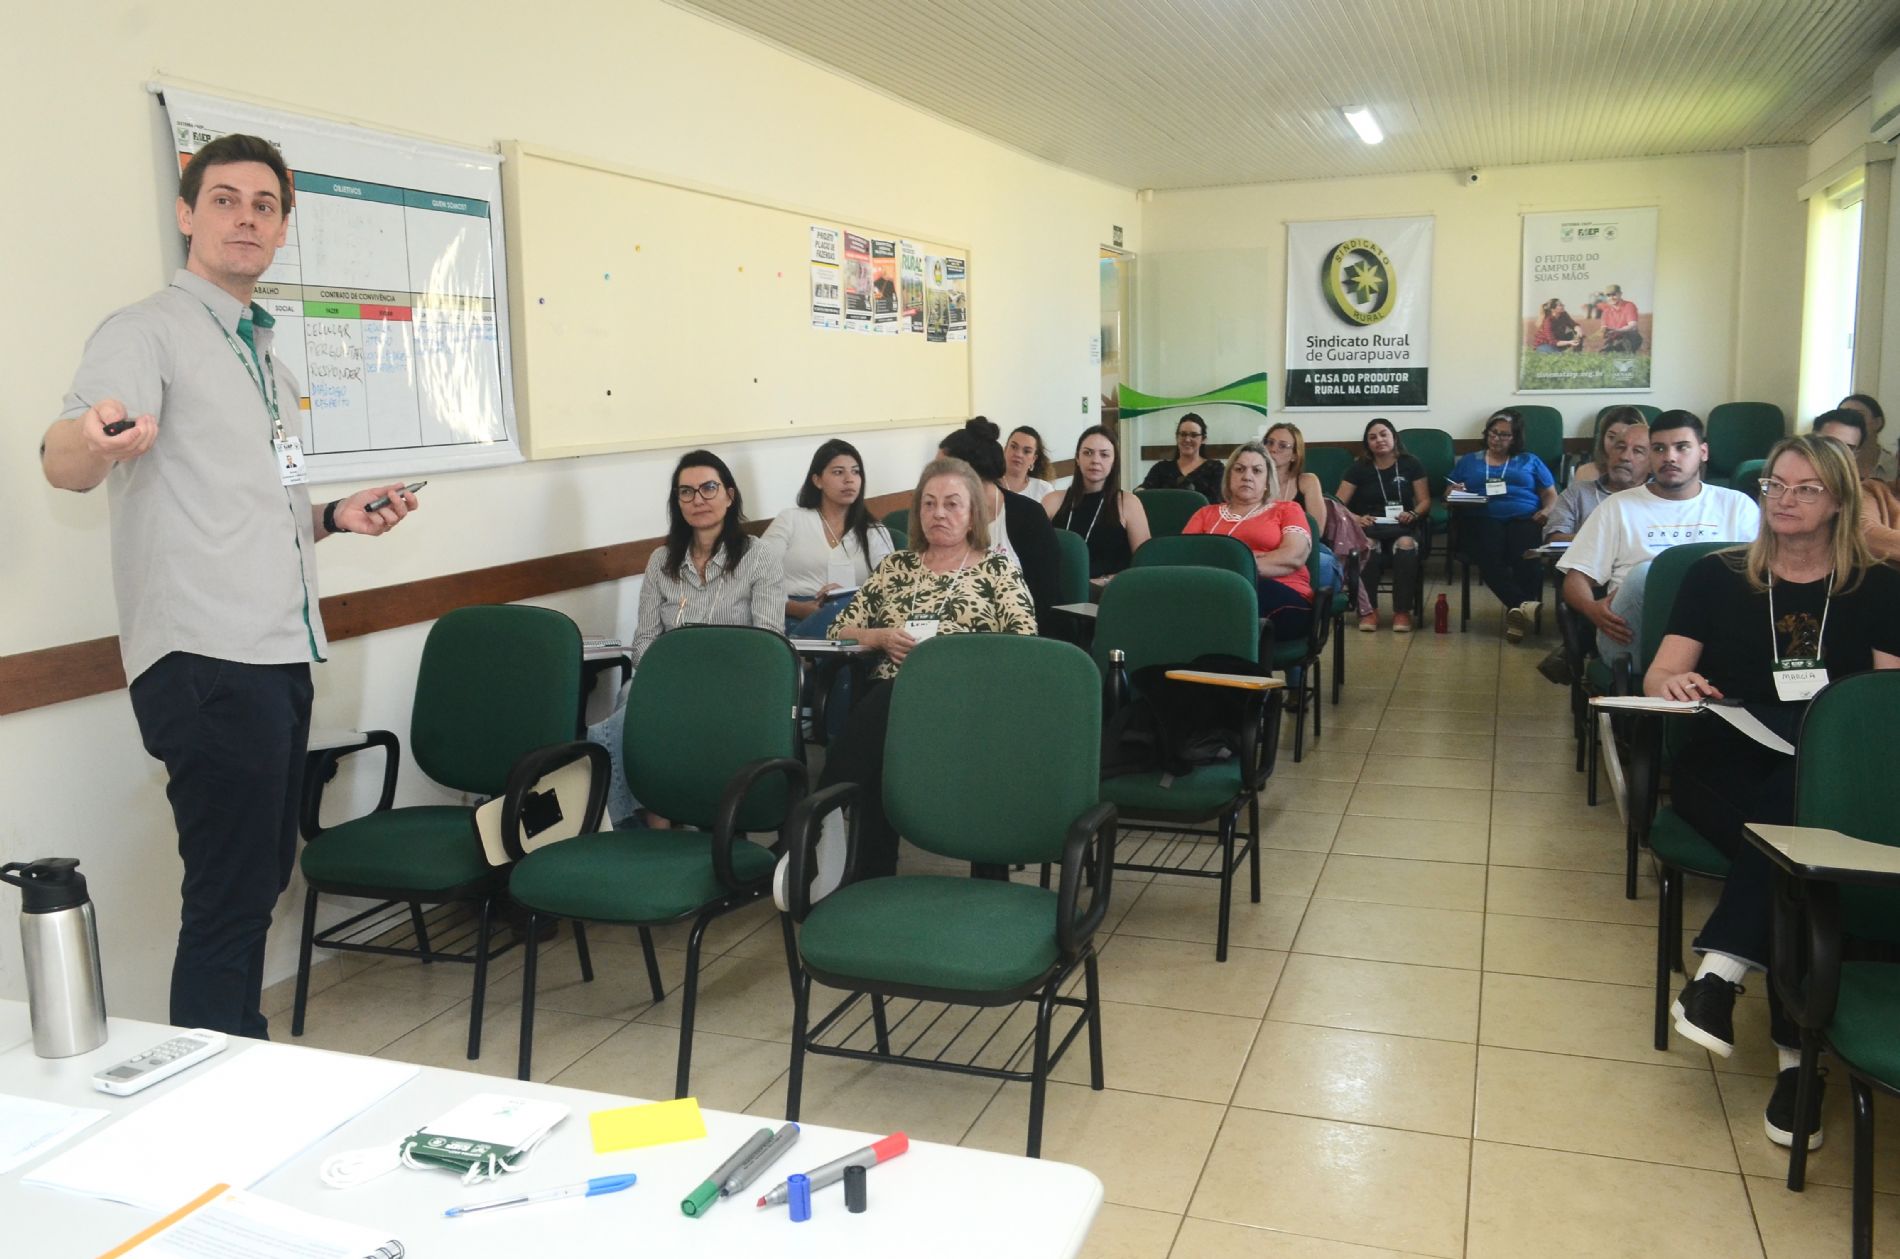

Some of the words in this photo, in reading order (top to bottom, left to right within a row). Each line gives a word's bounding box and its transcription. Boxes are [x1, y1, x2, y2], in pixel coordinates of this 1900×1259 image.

[1335, 239, 1390, 265] SINDICATO
[1535, 255, 1543, 263] O
[1544, 254, 1583, 263] FUTURO
[1586, 253, 1600, 261] DO
[1535, 264, 1569, 273] CAMPO
[1571, 263, 1586, 271] EM
[1534, 273, 1560, 282] SUAS
[1561, 272, 1590, 281] MÃOS
[254, 287, 280, 295] ABALHO
[320, 290, 350, 300] CONTRATO
[350, 292, 358, 300] DE
[358, 292, 396, 302] CONVIVÊNCIA
[1353, 311, 1385, 323] RURAL
[1306, 335, 1369, 348] Sindicato
[1373, 334, 1410, 347] Rural
[1306, 349, 1323, 361] de
[1327, 348, 1410, 363] Guarapuava
[1305, 375, 1312, 383] A
[1314, 374, 1340, 383] CASA
[1342, 373, 1355, 382] DO
[1357, 372, 1409, 382] PRODUTOR
[1314, 385, 1346, 395] RURAL
[1348, 385, 1361, 394] NA
[1364, 384, 1400, 394] CIDADE
